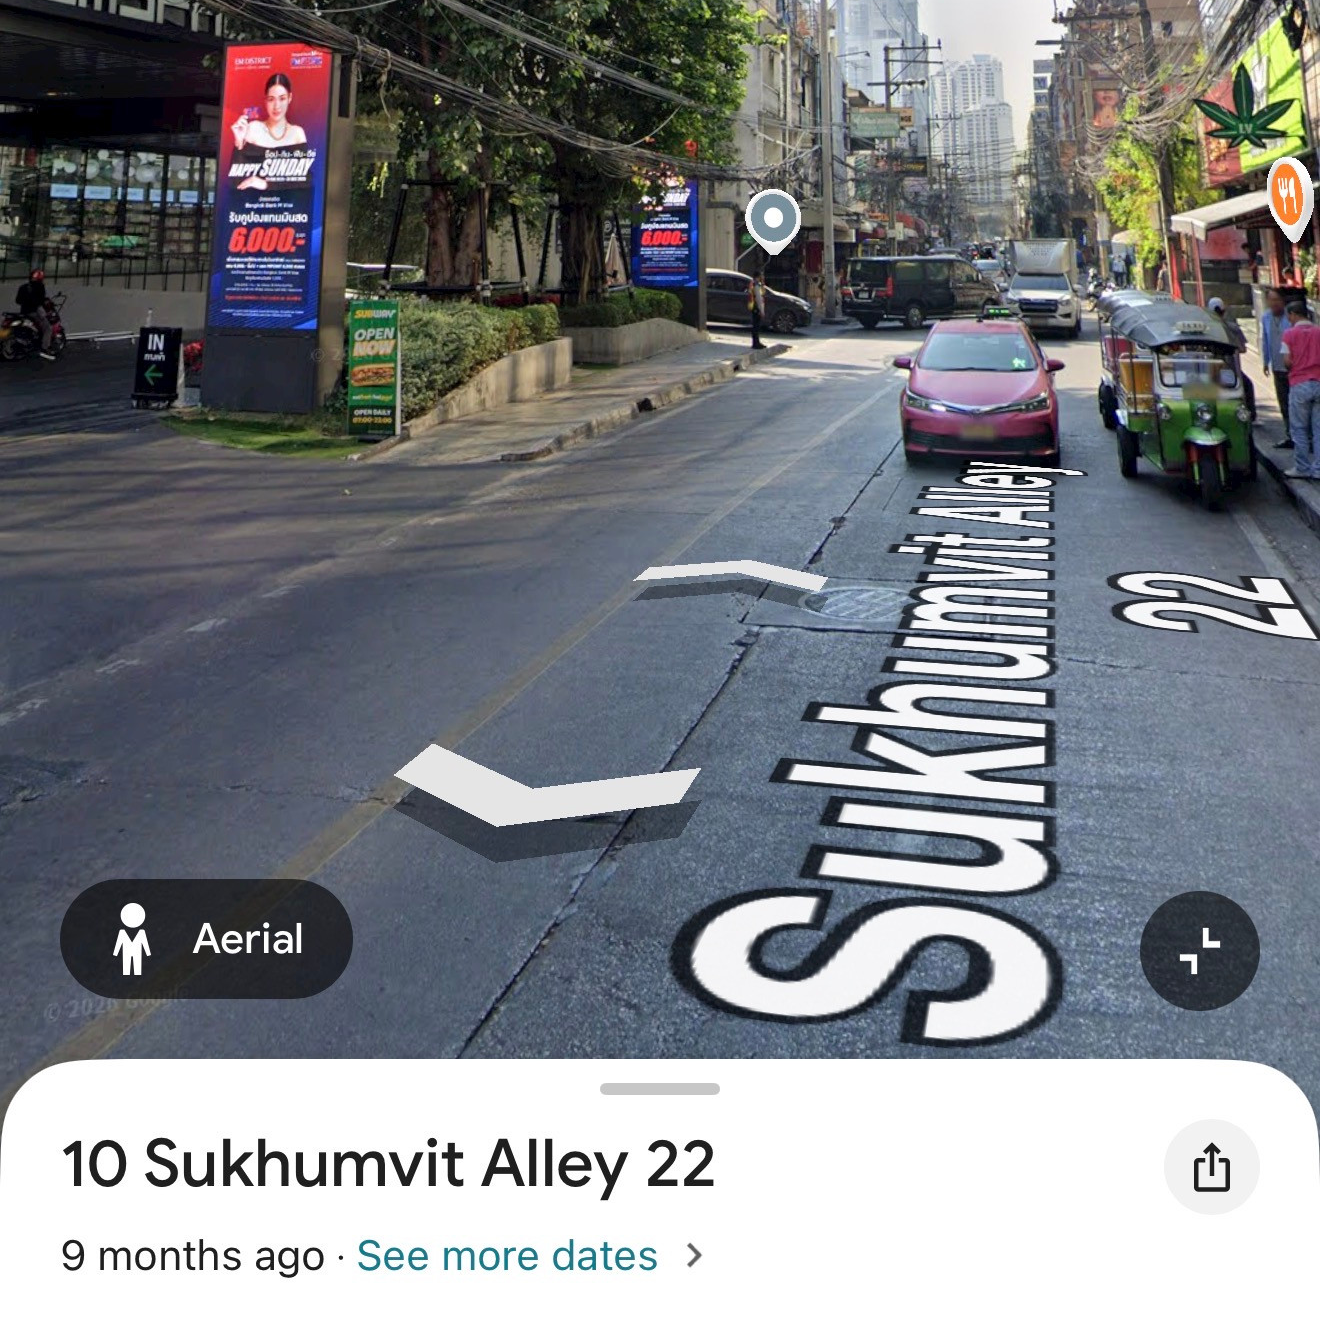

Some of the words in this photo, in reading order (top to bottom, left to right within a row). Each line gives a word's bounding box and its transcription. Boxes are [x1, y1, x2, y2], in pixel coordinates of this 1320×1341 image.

[228, 163, 261, 177] HAPPY
[259, 157, 315, 177] SUNDAY
[355, 309, 396, 319] SUBWAY
[354, 327, 395, 340] OPEN
[148, 334, 165, 350] IN
[353, 340, 396, 357] NOW
